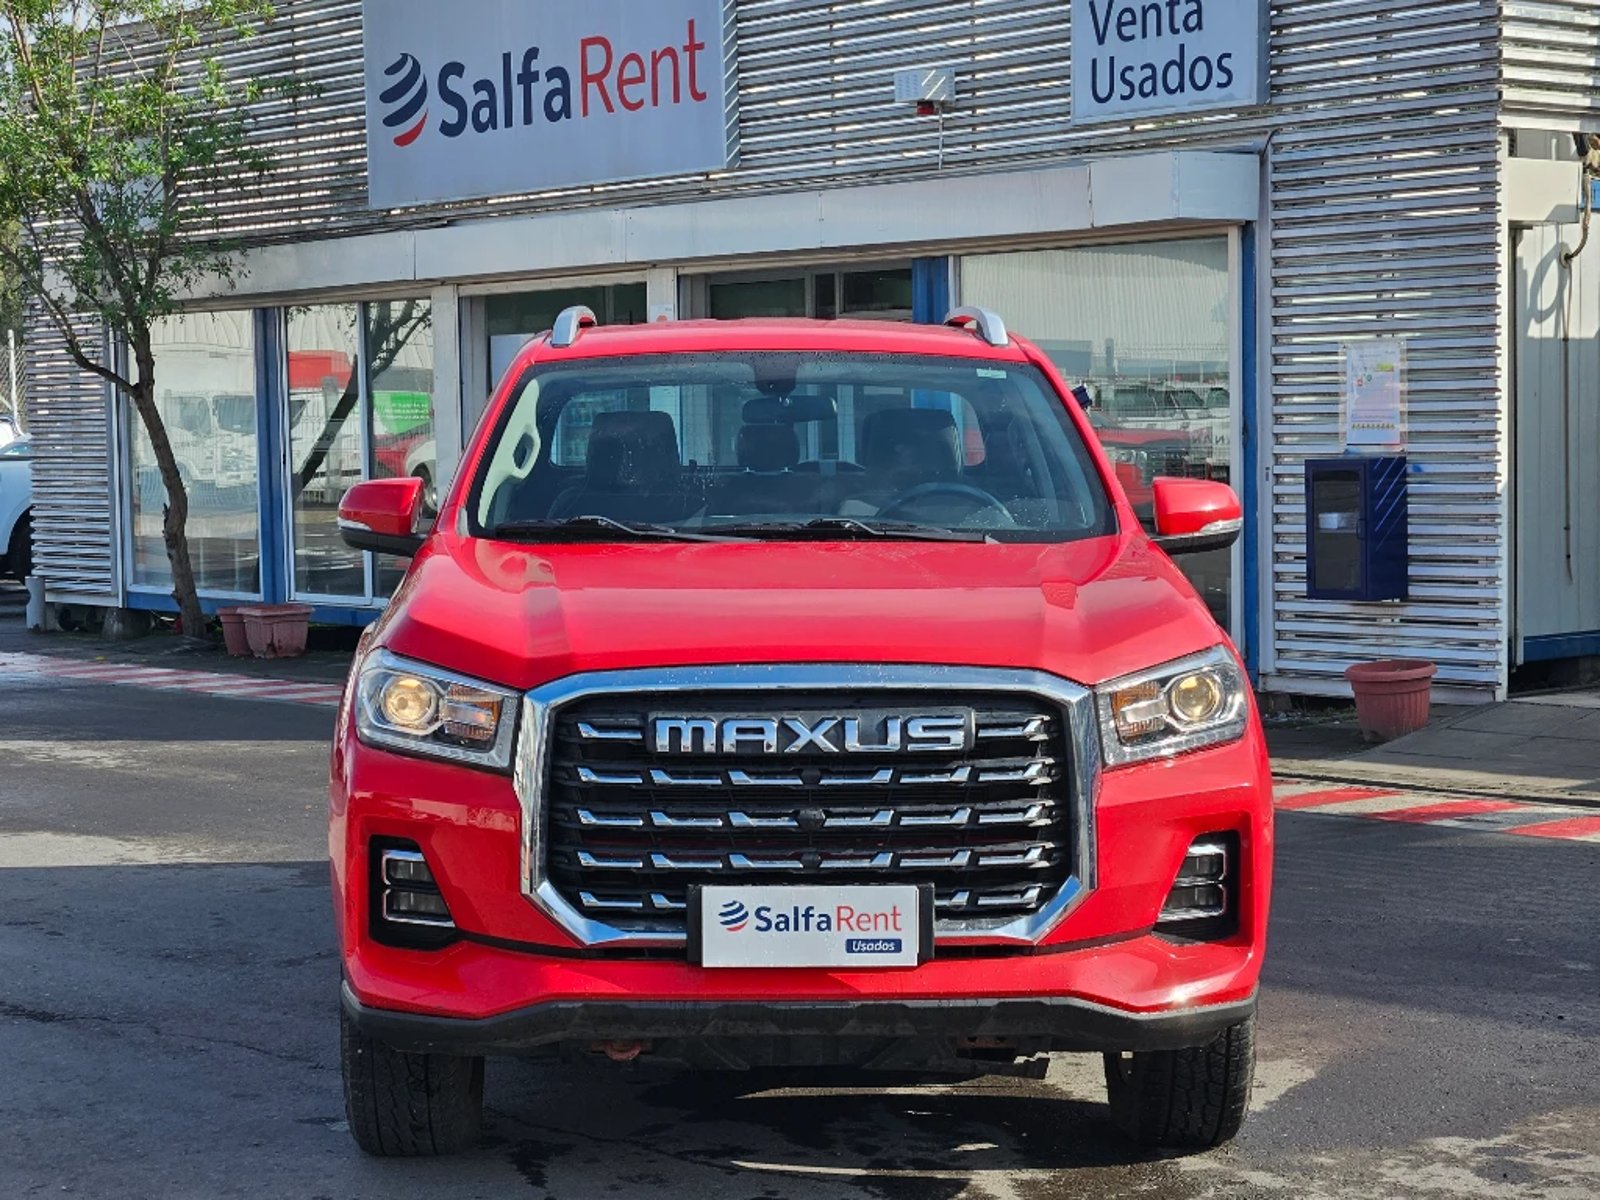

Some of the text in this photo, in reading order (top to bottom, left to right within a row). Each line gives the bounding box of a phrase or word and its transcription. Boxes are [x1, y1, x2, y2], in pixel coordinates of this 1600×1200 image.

[1088, 0, 1204, 46] Venta
[437, 18, 707, 138] SalfaRent
[1091, 43, 1234, 104] Usados
[652, 714, 970, 753] MAXUS
[754, 904, 903, 933] SalfaRent
[852, 939, 896, 952] Usados
